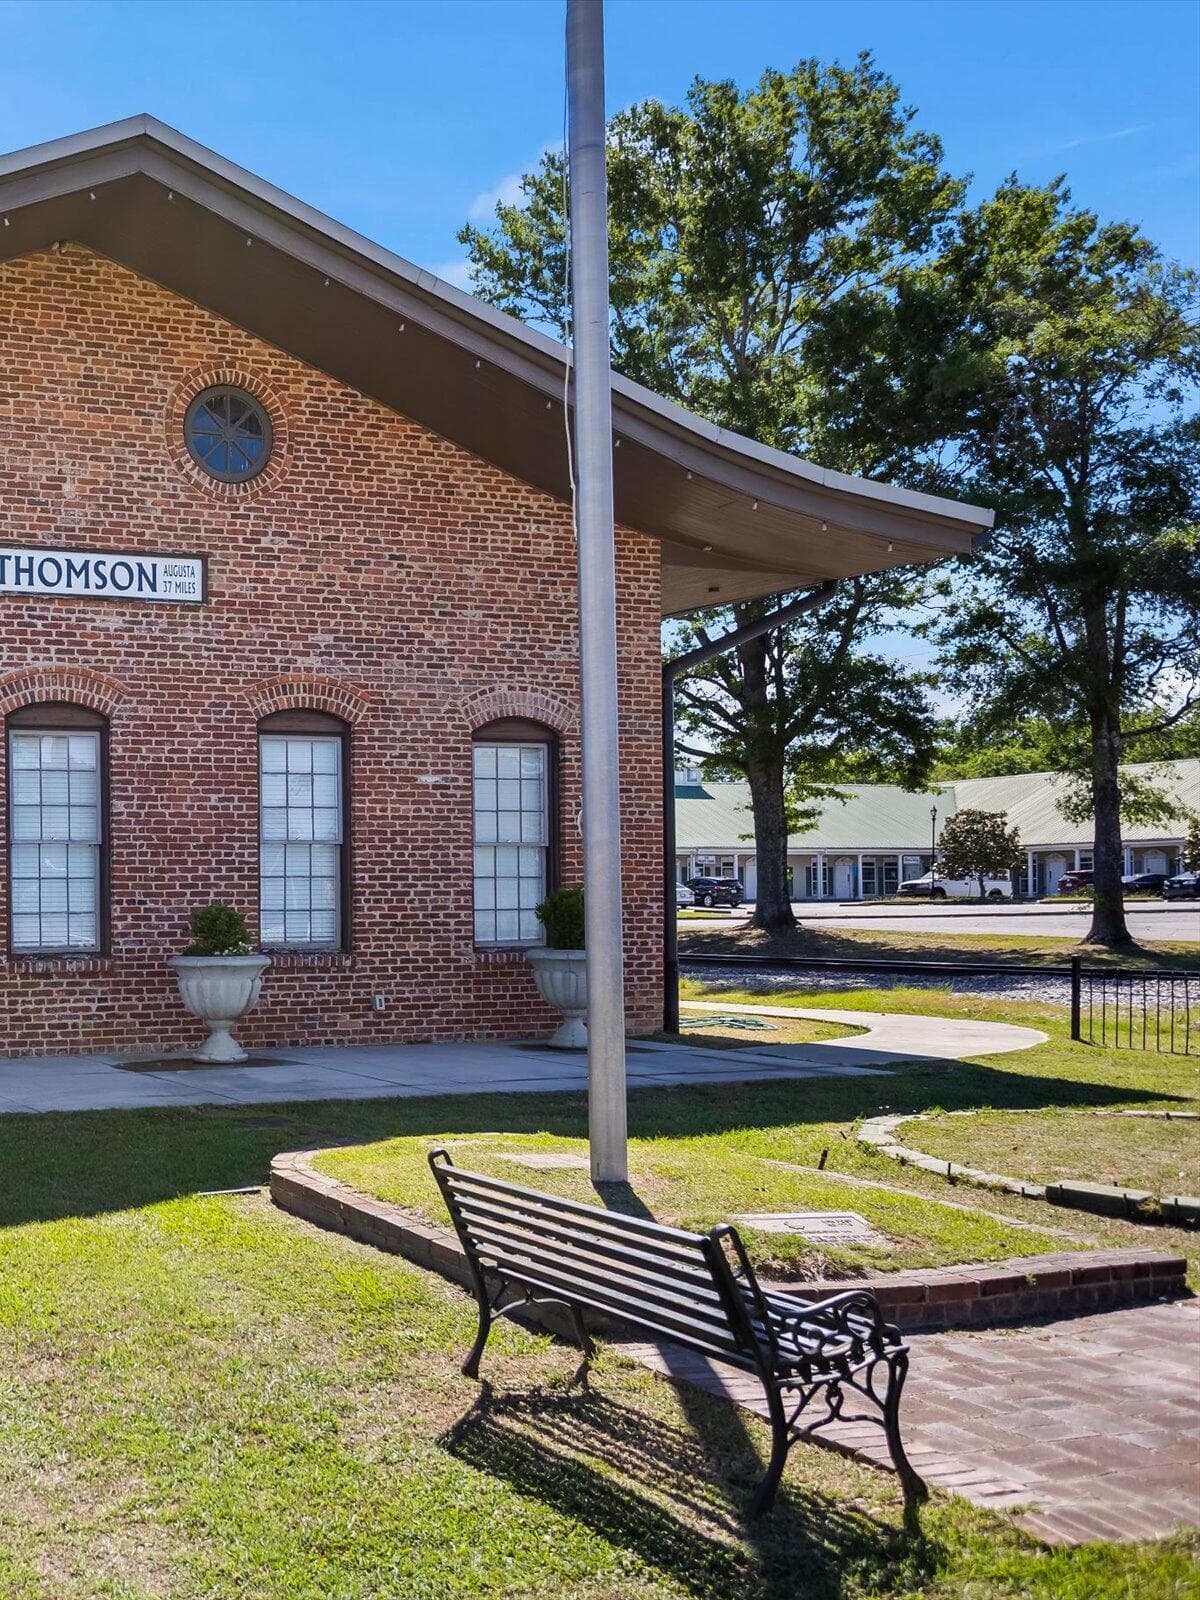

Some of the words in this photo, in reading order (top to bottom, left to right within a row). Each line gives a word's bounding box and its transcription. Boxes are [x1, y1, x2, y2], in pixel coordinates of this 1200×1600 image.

[163, 564, 196, 578] AUGUSTA
[163, 580, 172, 593] 37
[174, 581, 196, 594] MILES
